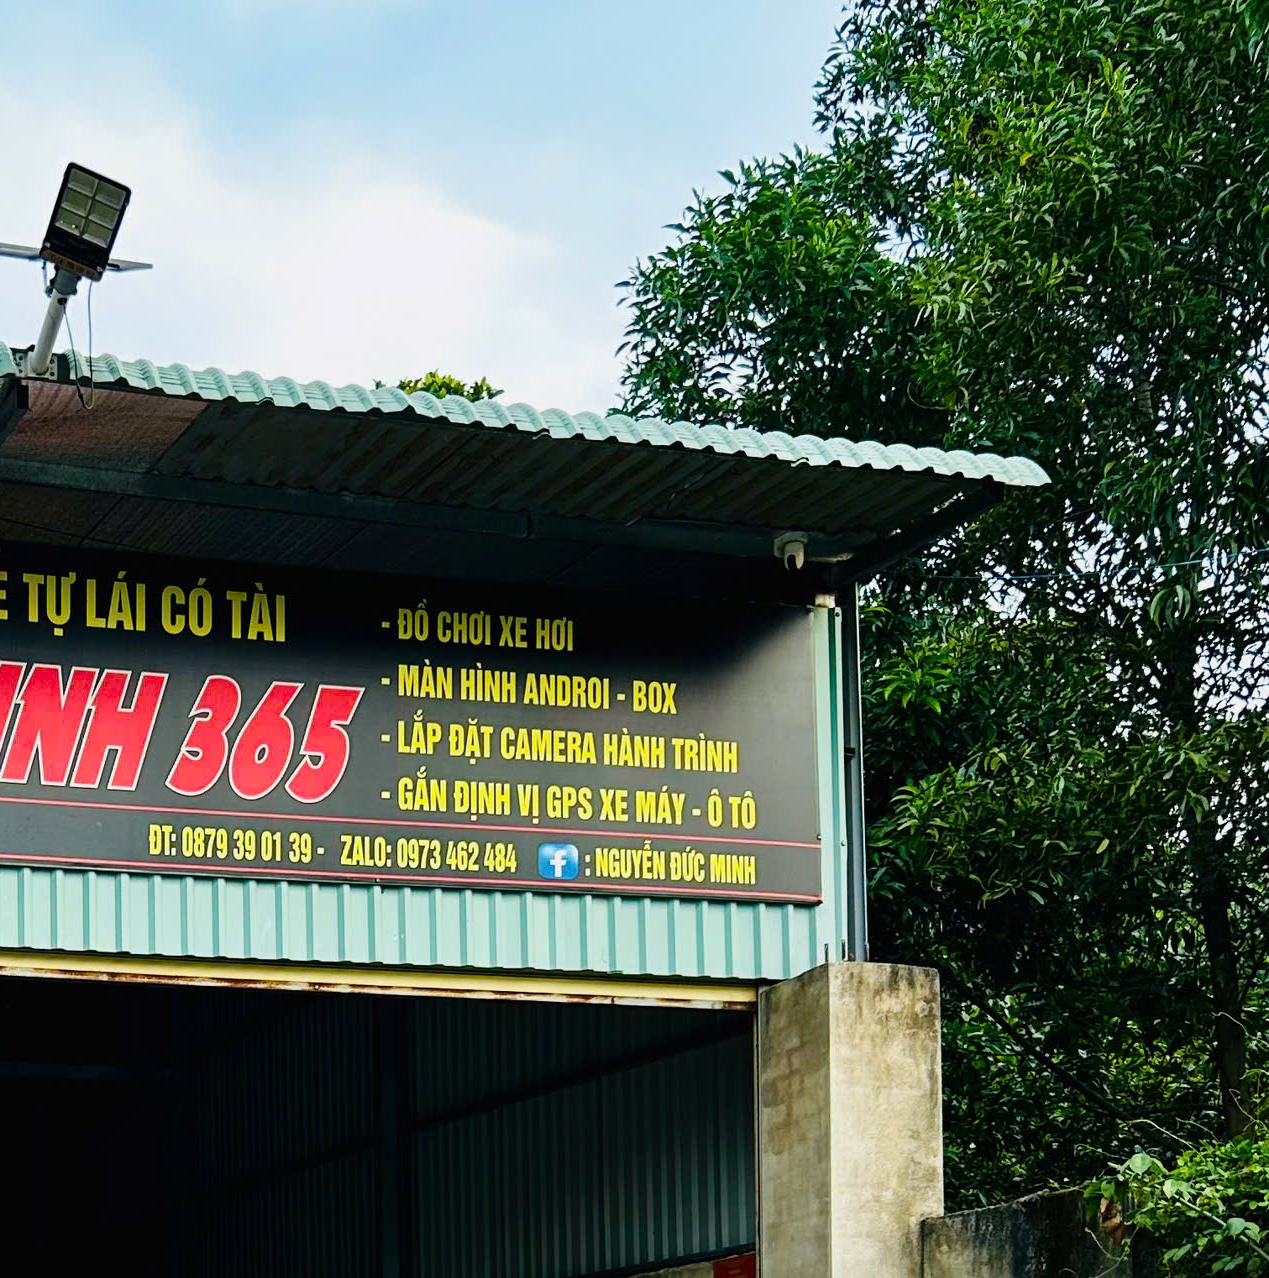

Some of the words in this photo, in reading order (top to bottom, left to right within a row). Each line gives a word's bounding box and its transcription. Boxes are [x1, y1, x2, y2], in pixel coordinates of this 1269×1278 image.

[23, 572, 76, 636] TỰ
[86, 570, 146, 632] LÁI
[161, 578, 212, 636] CÓ
[227, 582, 285, 642] TÀI
[397, 598, 429, 642] ĐỒ
[437, 610, 491, 646] CHƠI
[499, 615, 528, 648] XE
[536, 616, 573, 651] HƠI
[397, 658, 453, 699] MÀN
[460, 662, 517, 704] HÌNH
[523, 672, 609, 710] ANDROI
[633, 680, 677, 714] BOX
[164, 674, 365, 804] 365
[397, 709, 441, 755] LẮP
[449, 718, 493, 764] ĐẶT
[500, 726, 597, 764] CAMERA
[603, 728, 665, 769] HÀNH
[672, 733, 738, 774] TRÌNH
[397, 766, 447, 812] GẮN
[454, 778, 511, 822] ĐỊNH
[517, 784, 540, 824] VỊ
[547, 784, 593, 820] GPS
[599, 788, 629, 822] XE
[635, 786, 685, 825] MÁY
[708, 788, 723, 828] Ô
[729, 790, 755, 830] TÔ
[148, 824, 177, 856] ĐT:
[181, 826, 228, 859] 0879
[233, 829, 256, 862] 39
[261, 831, 282, 862] 01
[340, 835, 392, 868] ZALO:
[396, 838, 441, 869] 0973
[445, 840, 479, 872] 462
[483, 842, 517, 873] 484
[595, 840, 665, 880] NGUYỄN
[670, 846, 705, 882] ĐỨC
[710, 854, 757, 886] MINH
